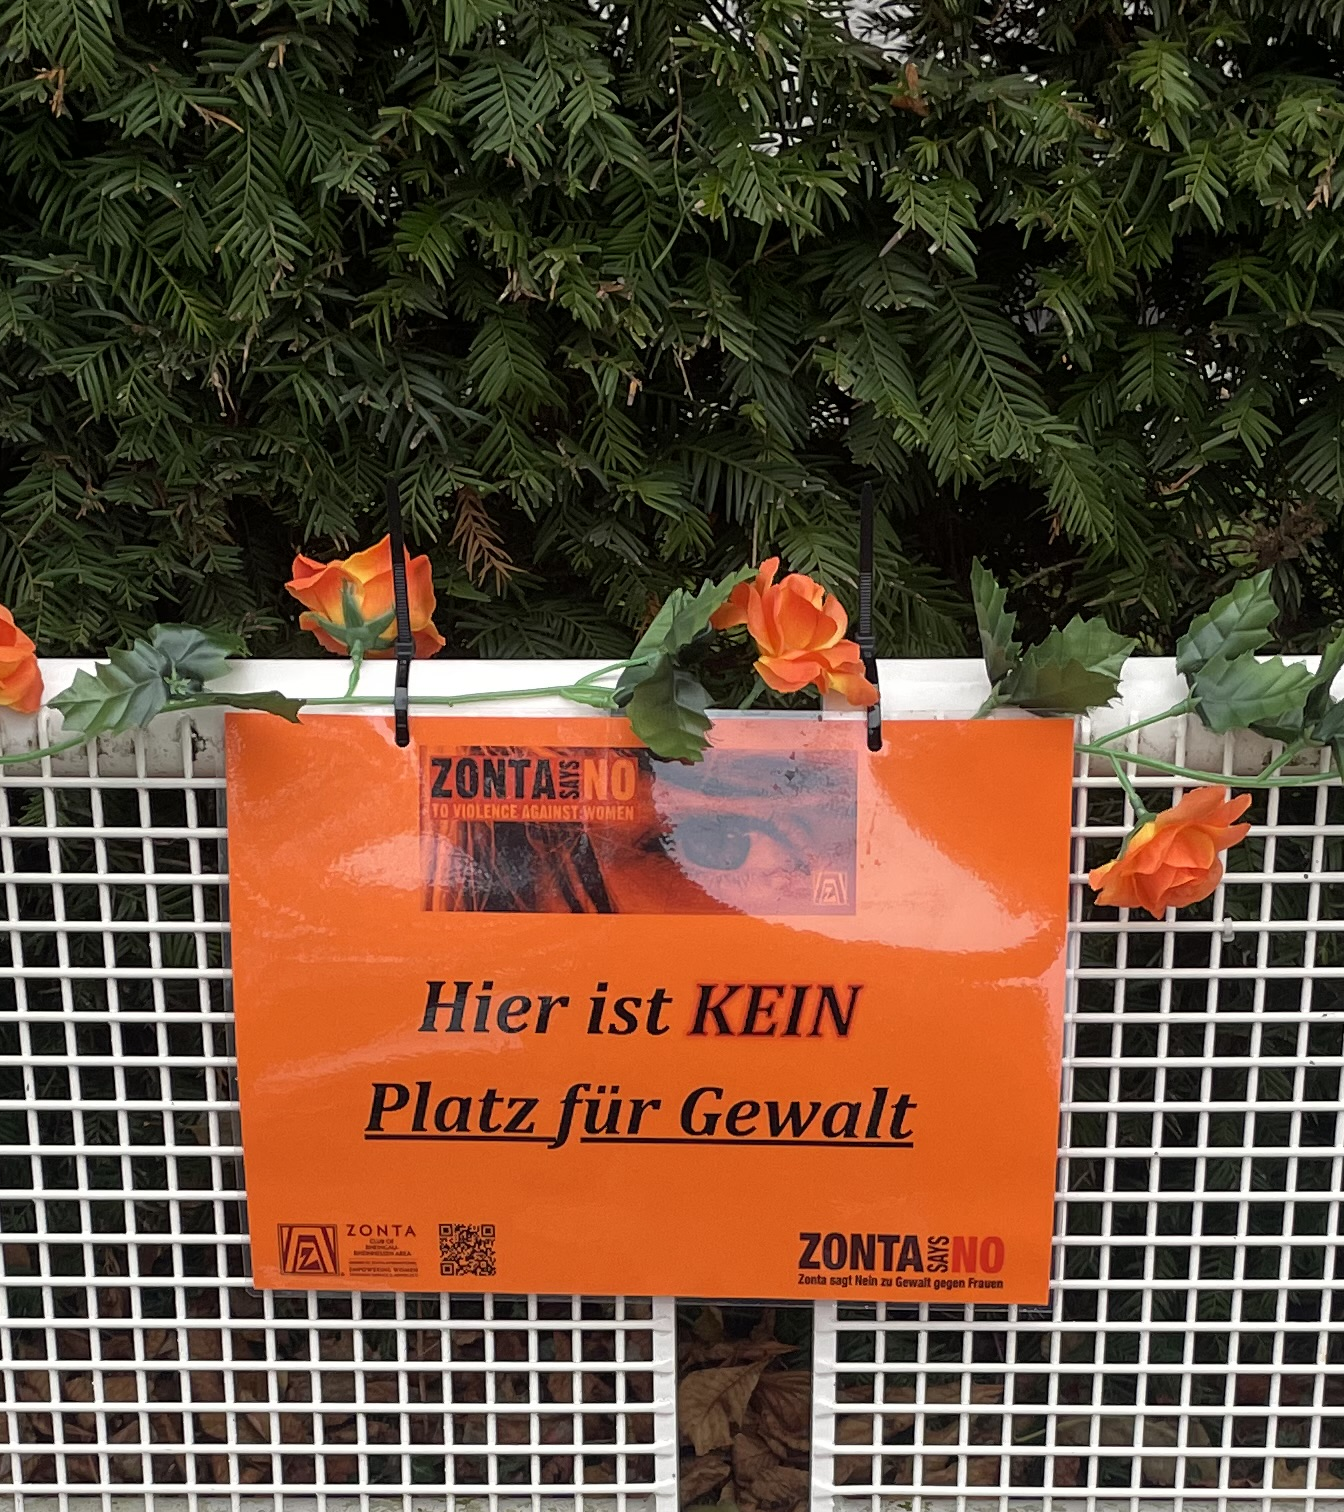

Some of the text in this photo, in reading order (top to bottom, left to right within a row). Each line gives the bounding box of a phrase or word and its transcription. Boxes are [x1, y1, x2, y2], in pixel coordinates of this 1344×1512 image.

[431, 757, 636, 802] ZONTA SAYS NO
[432, 803, 634, 822] TO VIOLENCE AGAINST WOMEN
[417, 979, 864, 1038] Hier ist KEIN
[364, 1081, 917, 1149] Platz für Gewalt
[346, 1224, 417, 1237] ZONTA
[798, 1232, 1005, 1274] ZONTA SAYS NO
[798, 1273, 1004, 1291] Zonta sagt Nein zu Gewalt gegen Frauen
